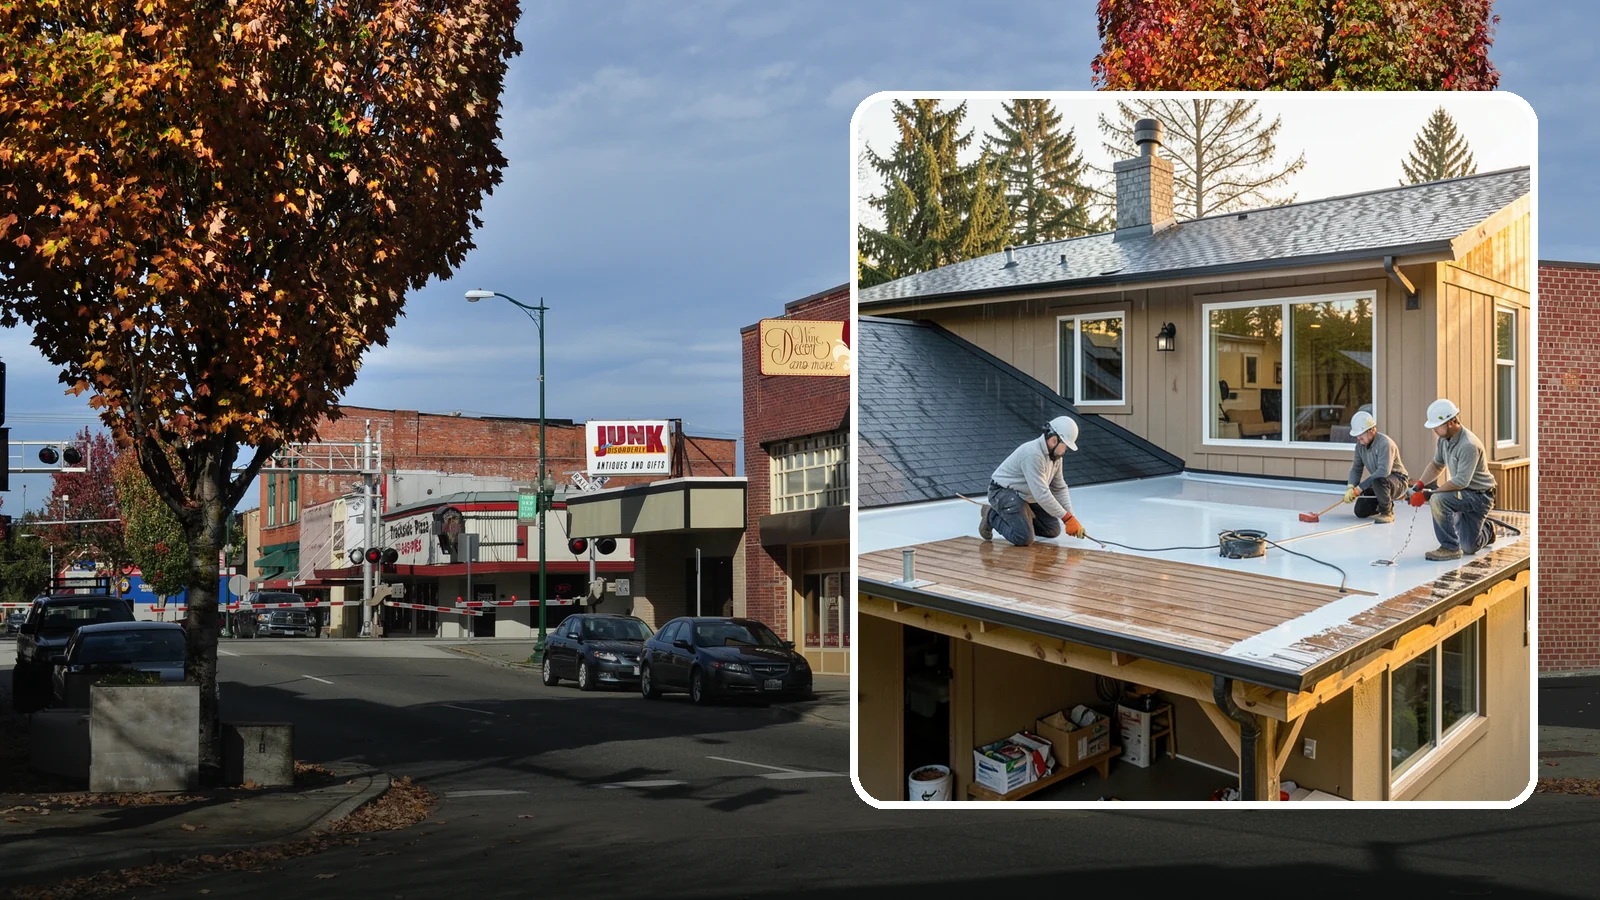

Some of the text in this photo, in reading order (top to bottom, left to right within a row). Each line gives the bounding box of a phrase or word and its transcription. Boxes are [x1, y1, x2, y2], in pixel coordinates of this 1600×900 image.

[765, 327, 831, 365] Decor
[595, 425, 664, 457] JUNK
[597, 460, 665, 470] ANTIQUES AND GIFTS
[414, 519, 429, 535] Pizza
